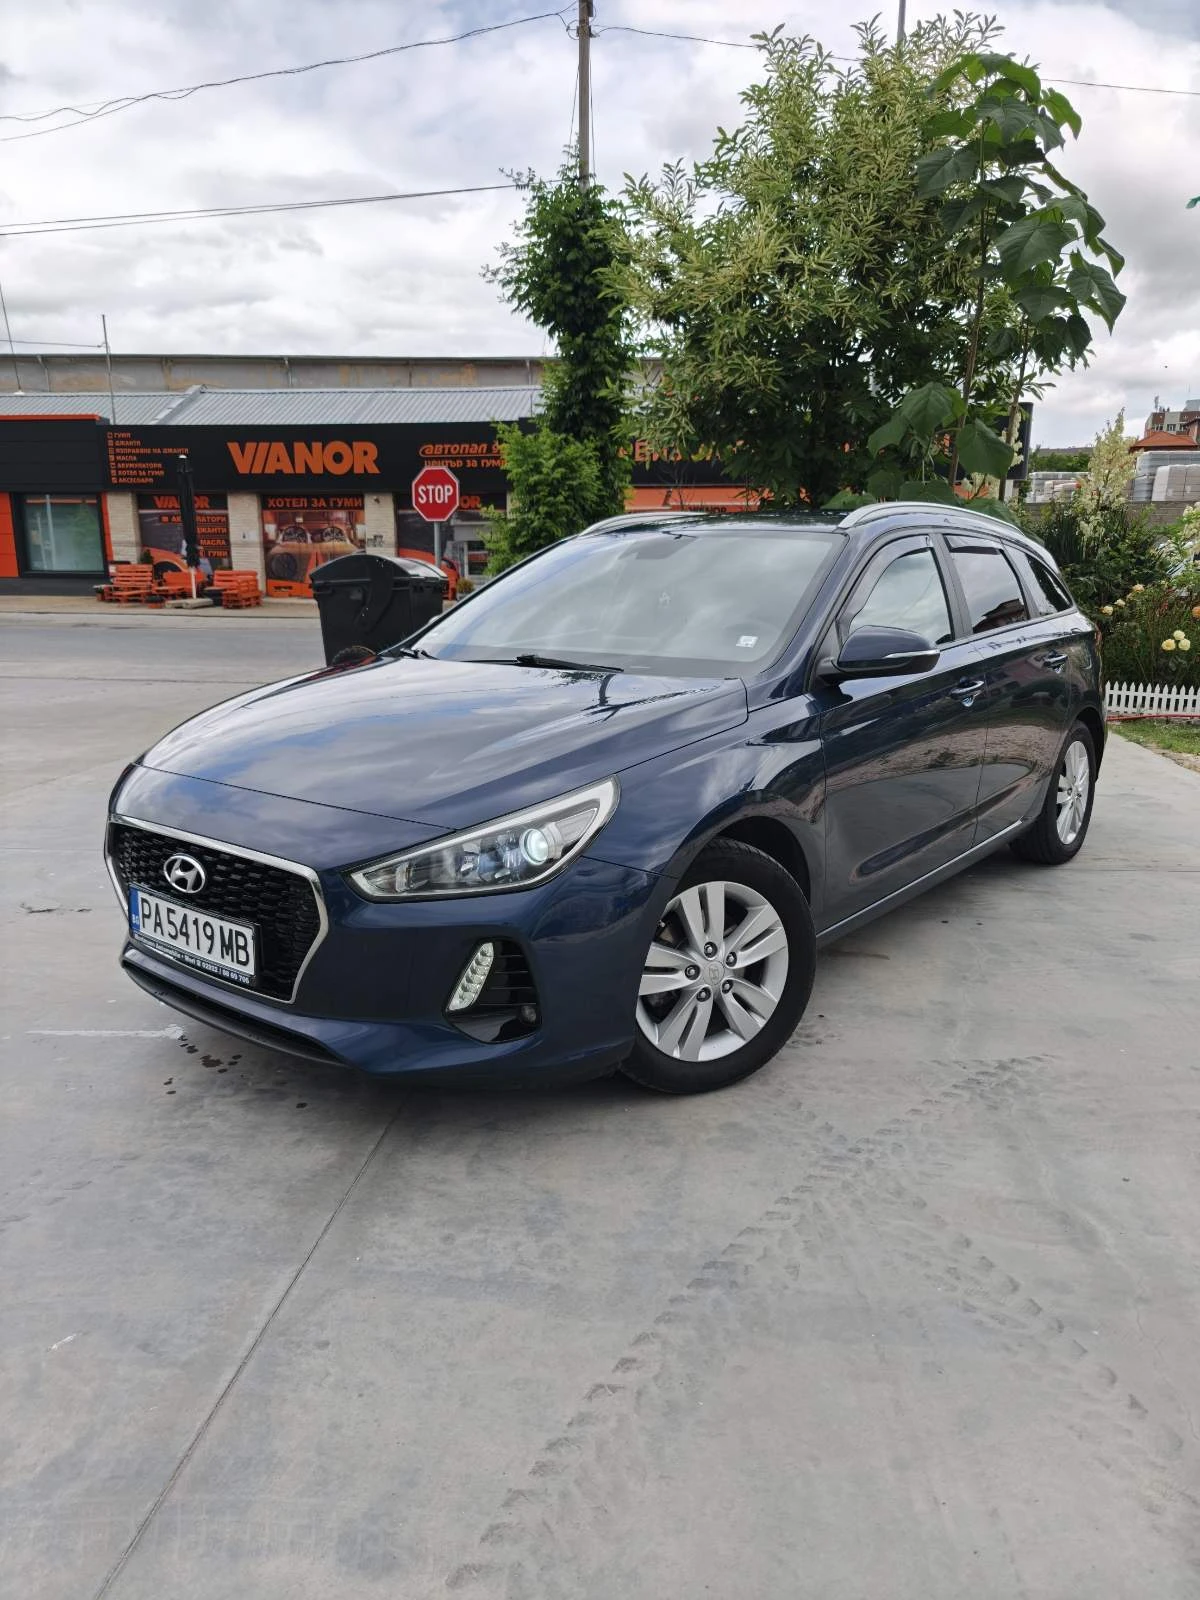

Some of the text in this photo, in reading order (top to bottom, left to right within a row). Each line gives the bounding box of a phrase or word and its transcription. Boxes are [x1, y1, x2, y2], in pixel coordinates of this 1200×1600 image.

[424, 443, 487, 455] автопал
[228, 441, 380, 475] VIANOR
[466, 459, 477, 468] за
[418, 485, 454, 504] STOP
[268, 497, 362, 507] ХОТЕЛ ЗА ГУМИ
